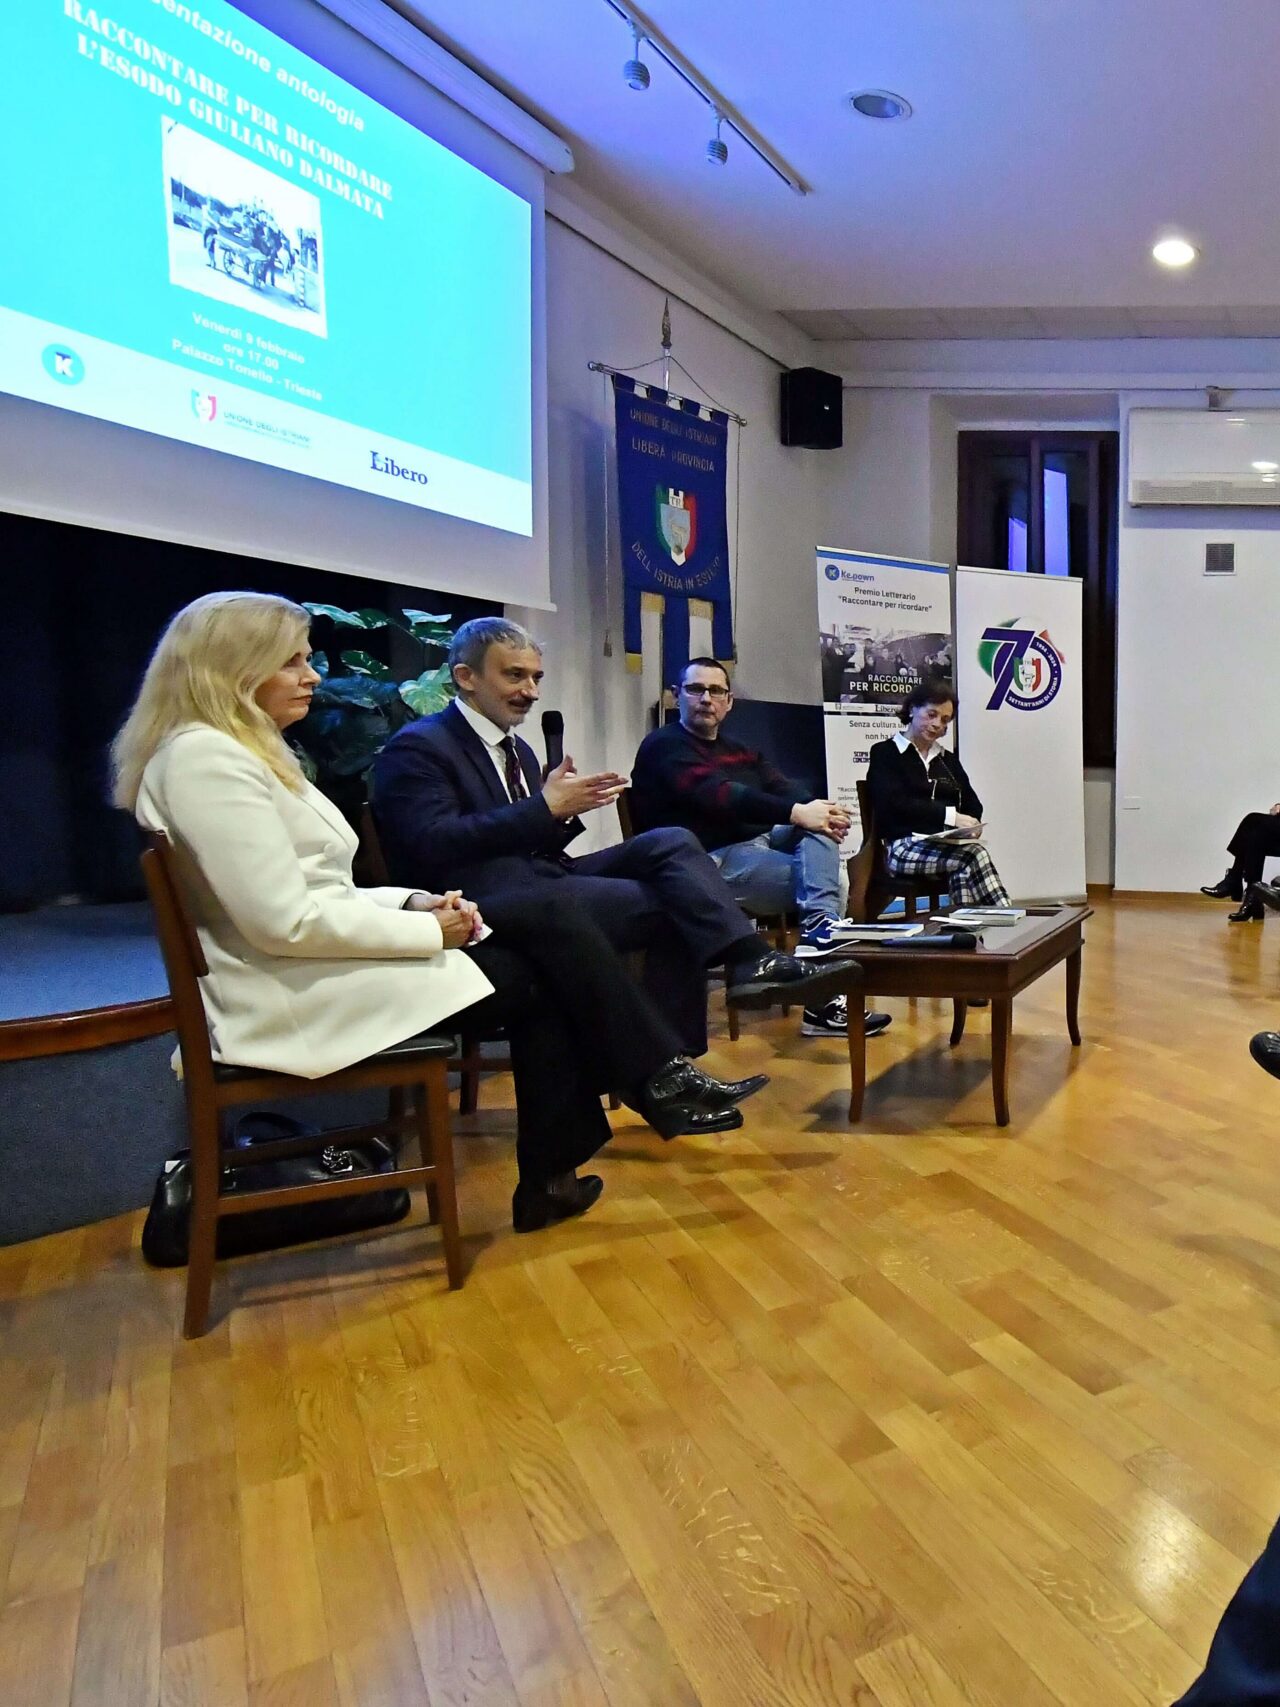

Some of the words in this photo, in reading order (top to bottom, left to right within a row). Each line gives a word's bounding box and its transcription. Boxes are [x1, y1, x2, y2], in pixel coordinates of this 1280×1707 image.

[152, 0, 271, 73] entazione
[276, 67, 365, 133] antologia
[64, 0, 229, 107] RACCONTARE
[236, 95, 279, 136] PER
[285, 123, 393, 202] RICORDARE
[189, 97, 294, 168] GIULIANO
[299, 157, 385, 221] DALMATA
[223, 343, 244, 358] ore
[246, 332, 254, 345] 9
[256, 336, 305, 365] febbraio
[172, 338, 224, 367] Palazzo
[227, 357, 273, 385] Tonello
[284, 378, 323, 401] Trieste
[630, 408, 659, 428] UNIONE
[632, 436, 666, 458] LIBERA
[671, 450, 715, 473] PROVINCIA
[369, 450, 428, 485] Libero
[654, 568, 684, 590] ISTRIA
[685, 579, 694, 590] IN
[854, 586, 881, 597] Premio
[881, 589, 916, 601] Letterario
[884, 602, 897, 610] per
[849, 681, 869, 692] PER
[873, 682, 914, 694] RICORD
[868, 674, 922, 685] RACCONTARE
[849, 719, 871, 728] Senza
[872, 720, 897, 728] cultura
[880, 732, 889, 740] ha
